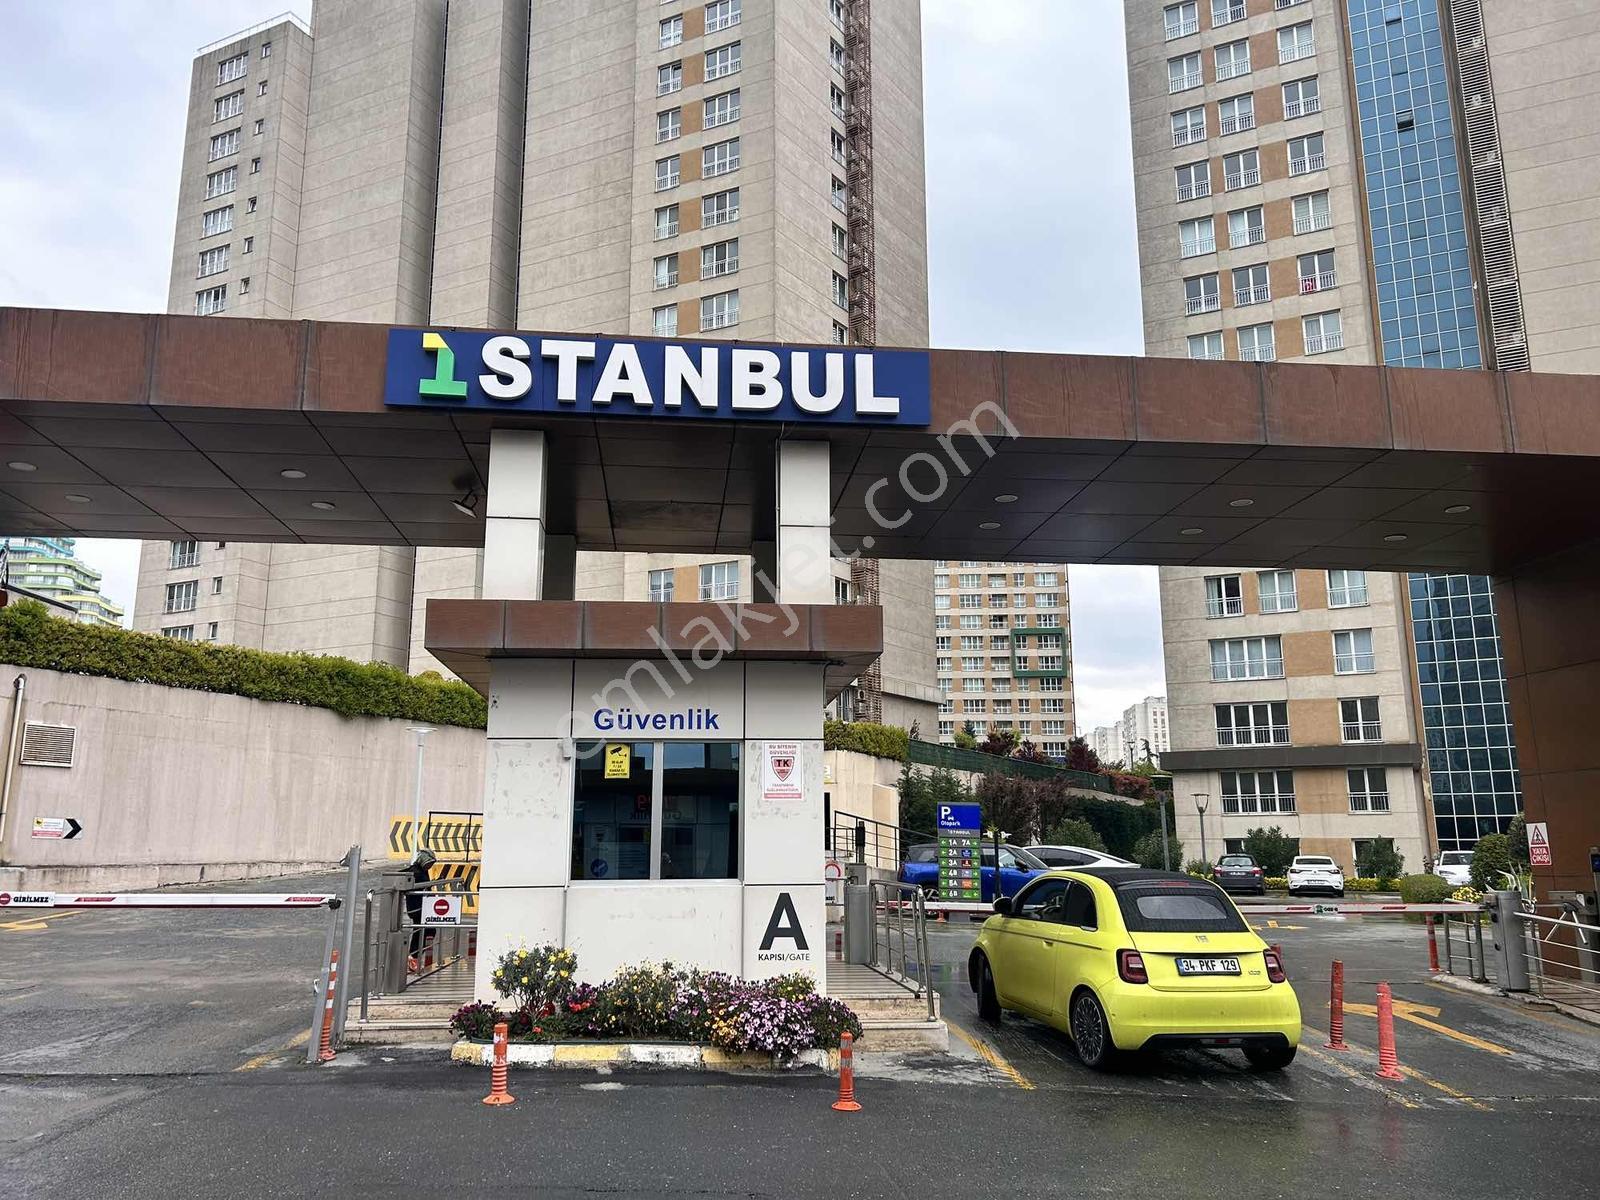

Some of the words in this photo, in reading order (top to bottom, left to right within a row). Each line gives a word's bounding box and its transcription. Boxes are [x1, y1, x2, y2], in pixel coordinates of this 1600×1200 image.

[593, 708, 722, 731] Güvenlik
[776, 759, 790, 767] TK
[941, 806, 951, 820] P
[1531, 847, 1547, 855] YAYA
[758, 892, 810, 951] A
[758, 953, 810, 962] KAPISI/GATE
[1182, 959, 1195, 971] 34
[1198, 959, 1216, 971] PKF
[1220, 959, 1237, 971] 129
